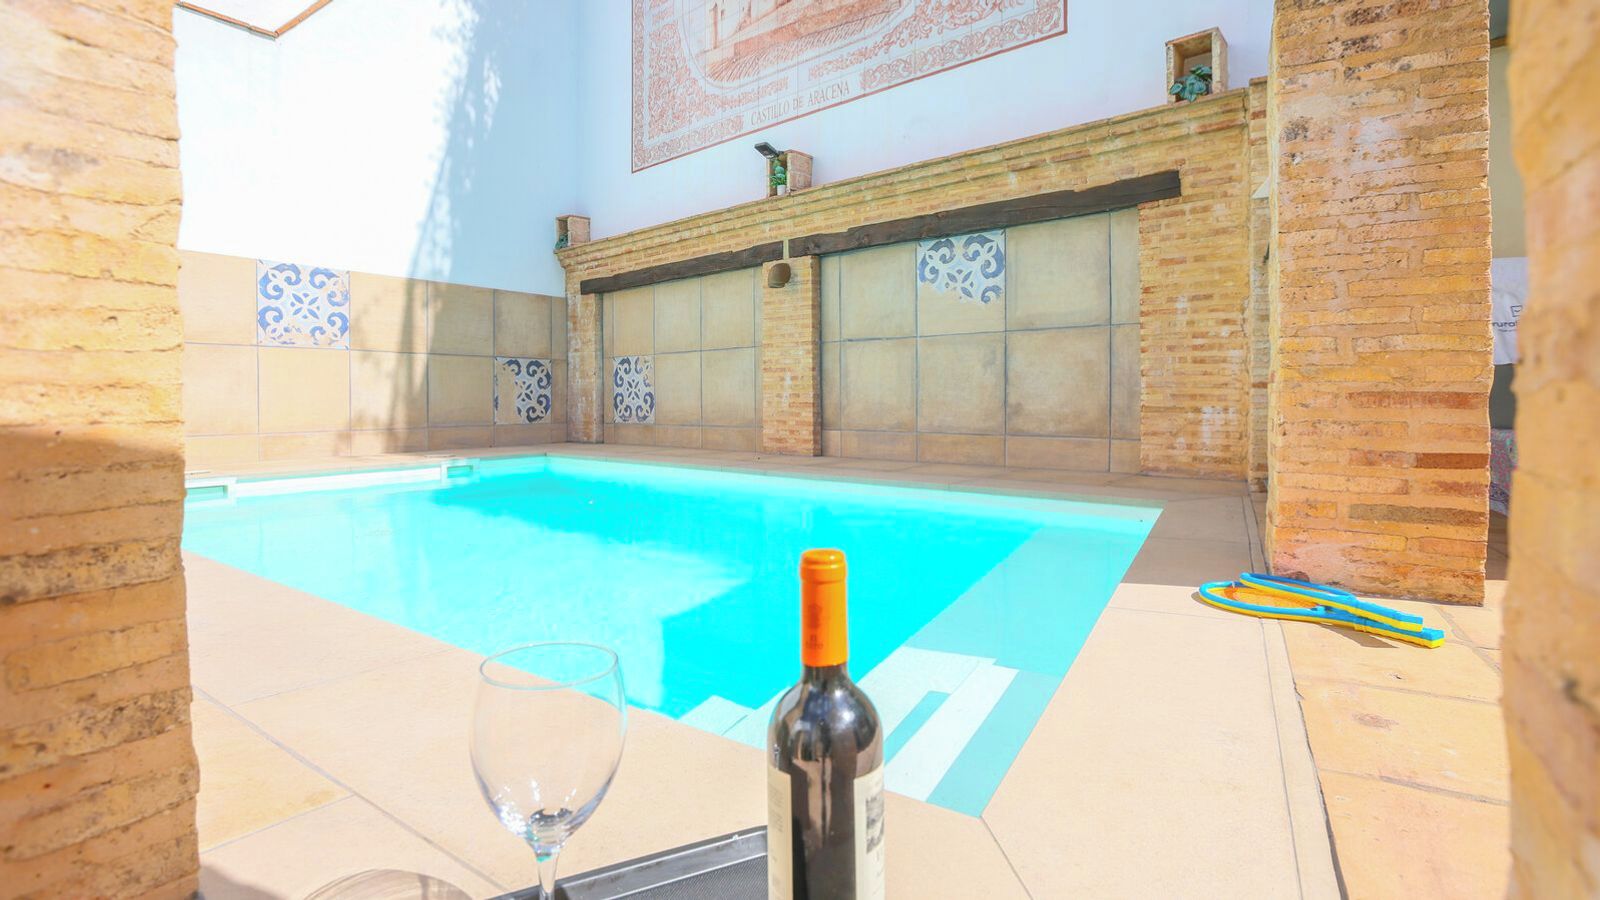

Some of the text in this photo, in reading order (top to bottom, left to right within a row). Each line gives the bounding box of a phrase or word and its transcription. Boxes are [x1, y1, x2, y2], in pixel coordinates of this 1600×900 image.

[751, 81, 850, 126] CASTILLO DE ARACENA
